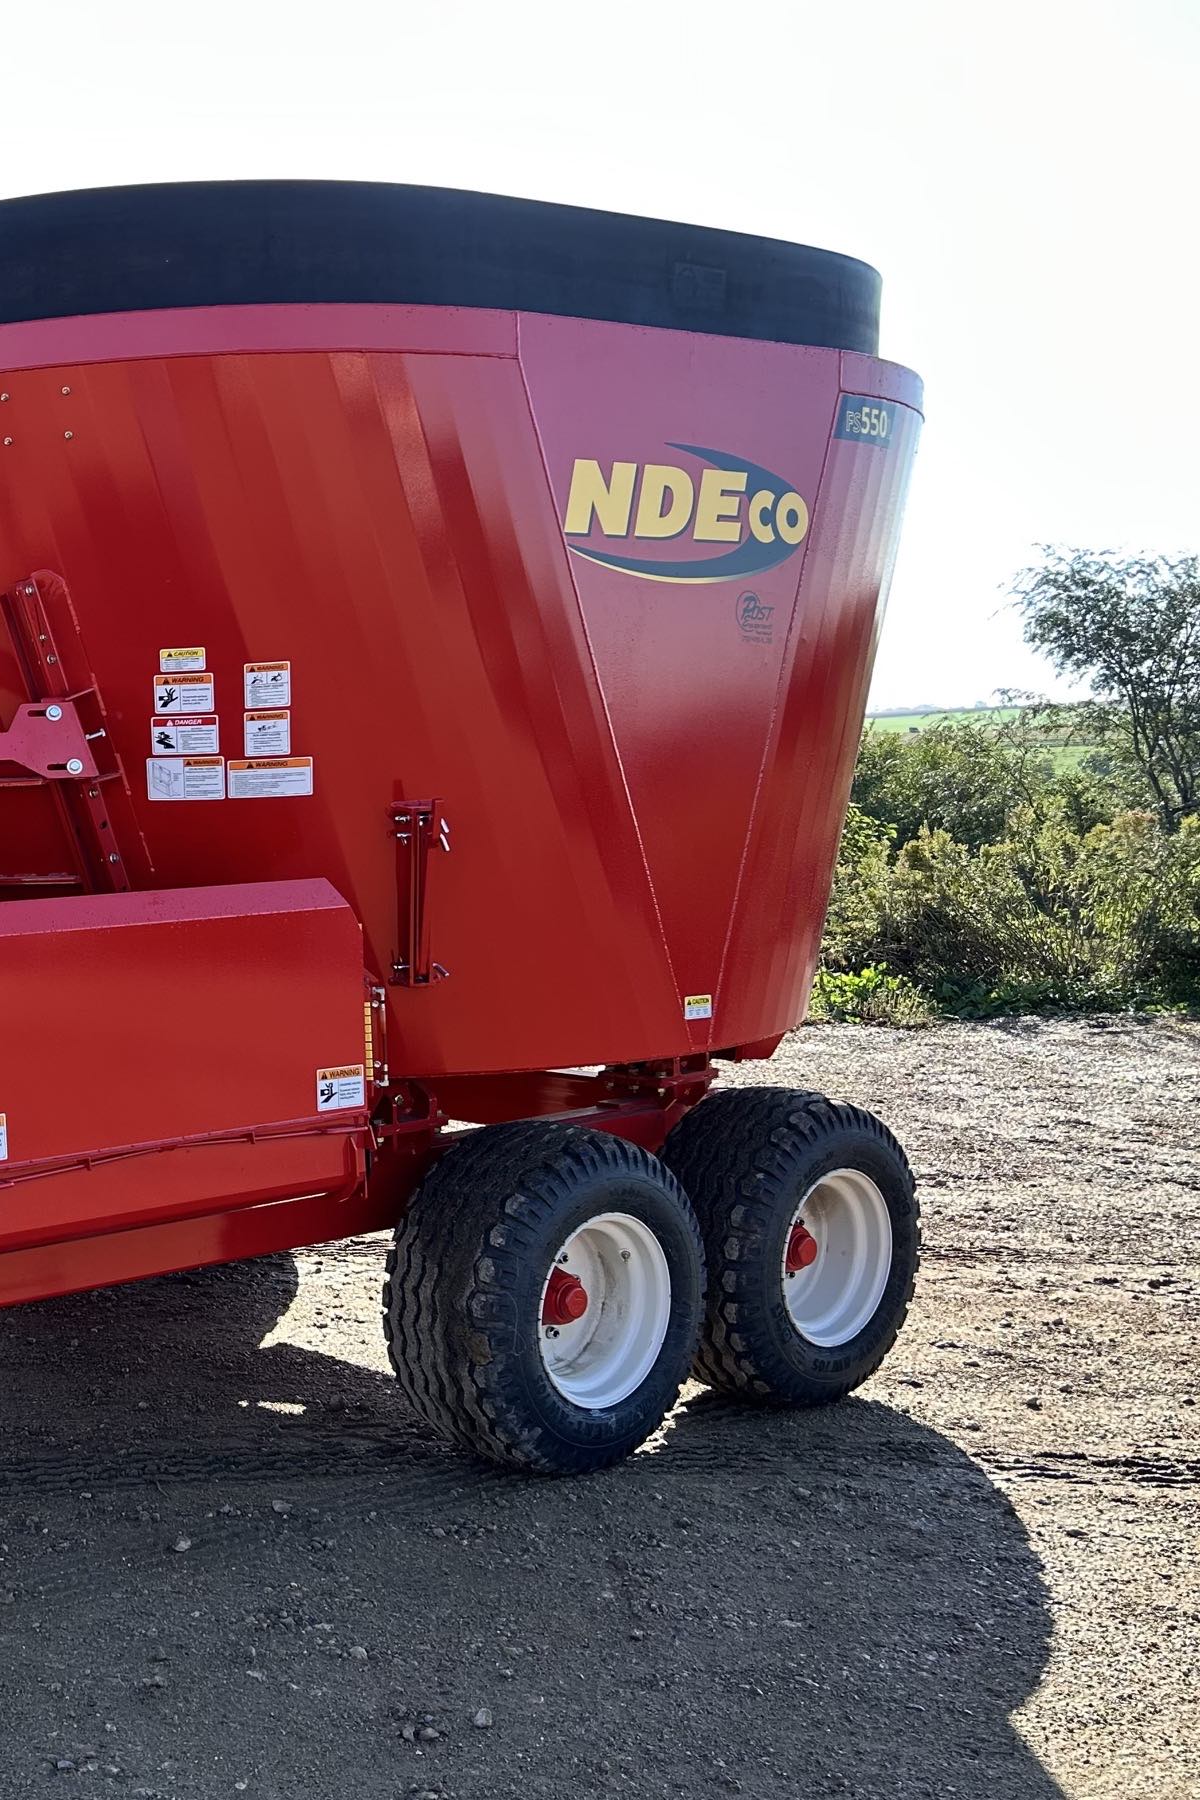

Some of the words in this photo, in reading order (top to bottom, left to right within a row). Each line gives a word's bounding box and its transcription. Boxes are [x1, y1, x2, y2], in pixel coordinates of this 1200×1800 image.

[174, 718, 203, 726] DANGER
[255, 760, 288, 768] WARNING
[329, 1067, 360, 1078] WARNING
